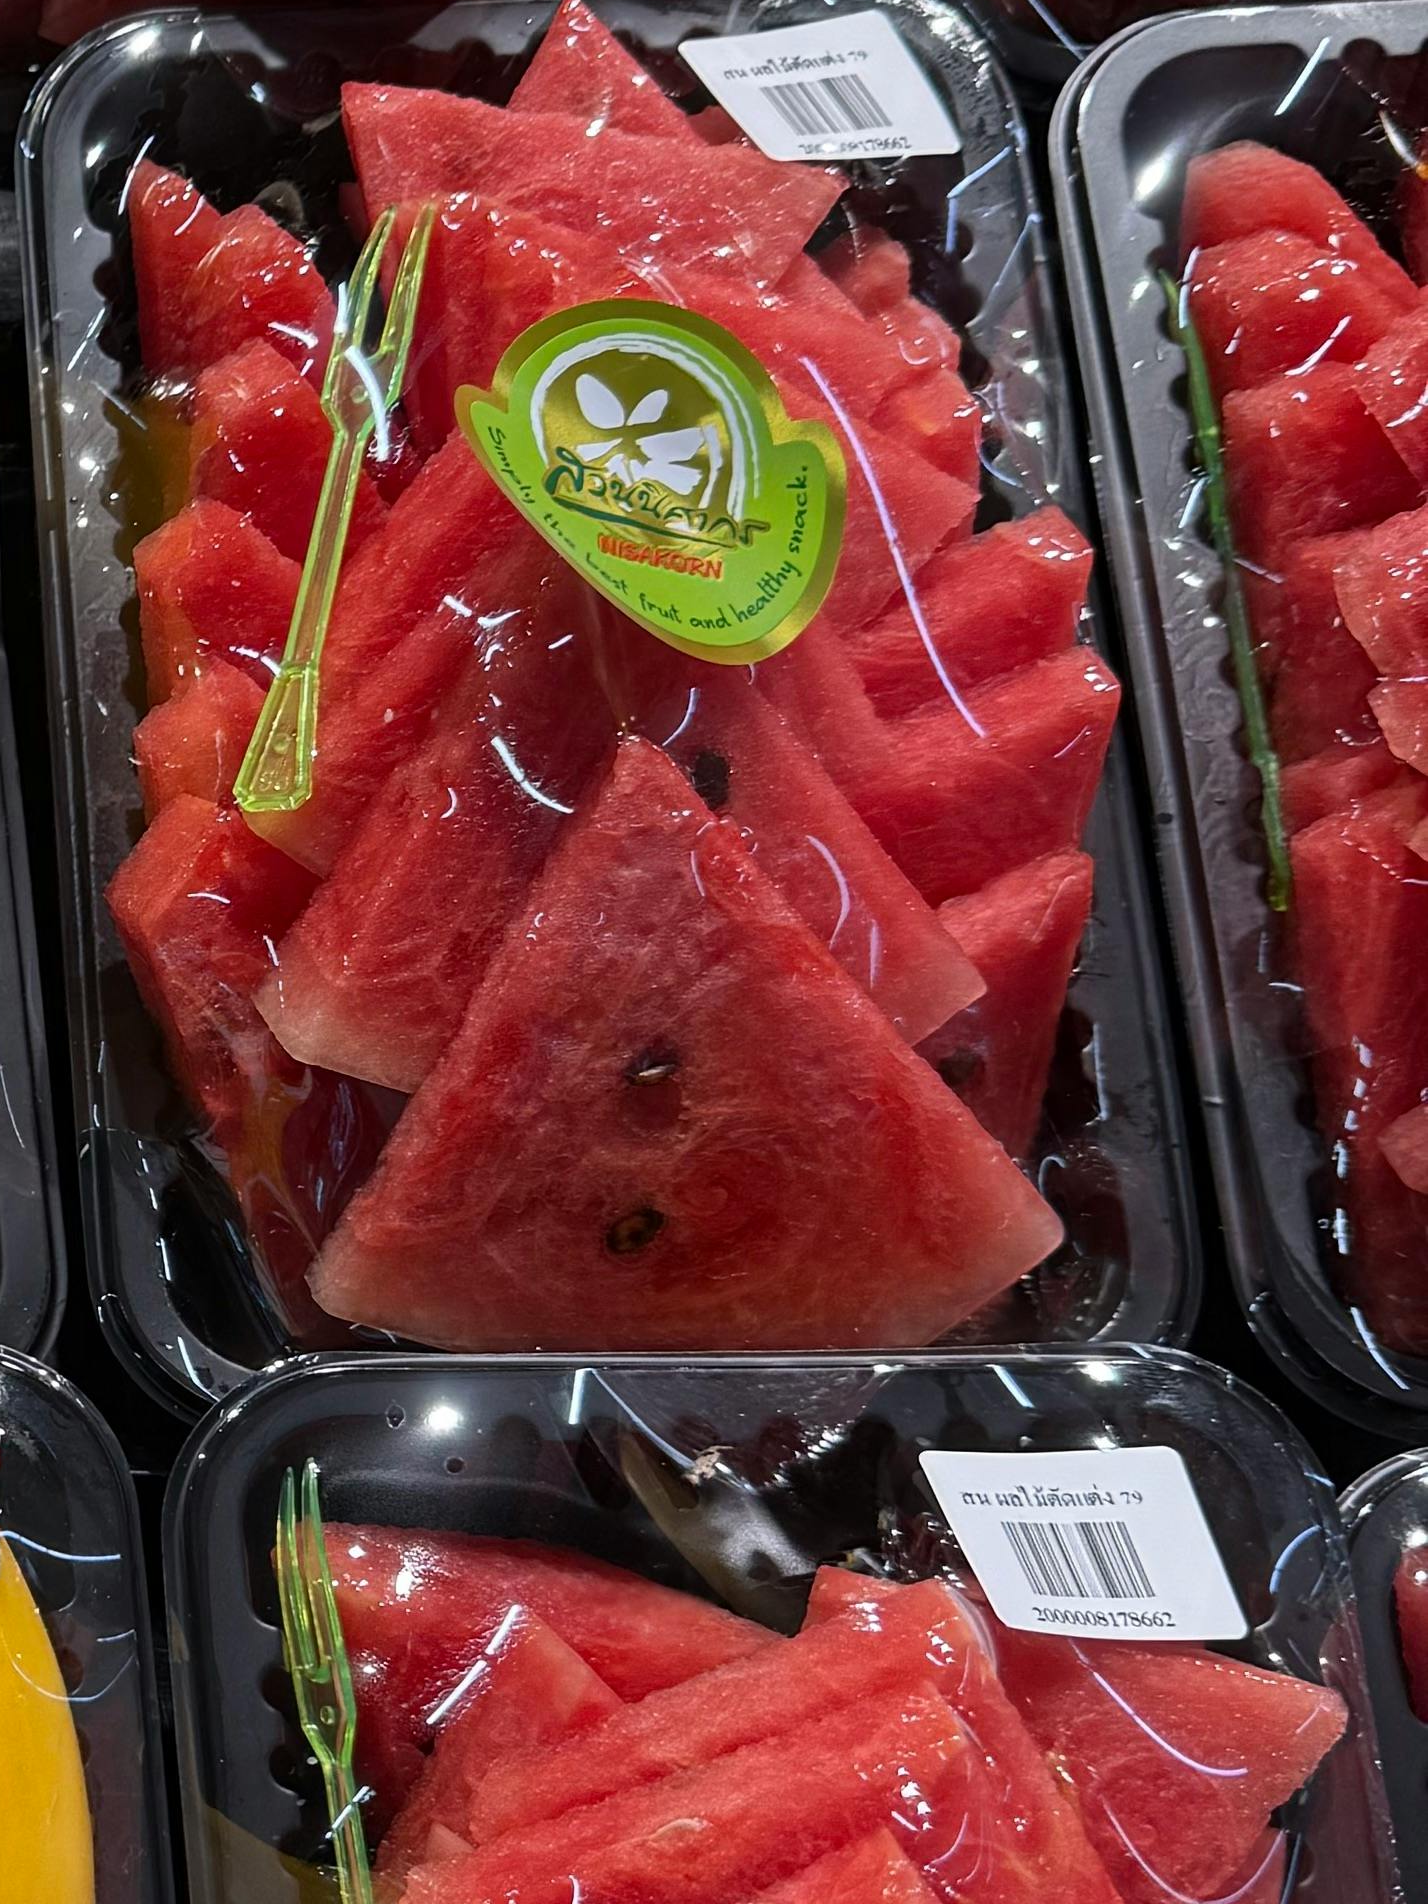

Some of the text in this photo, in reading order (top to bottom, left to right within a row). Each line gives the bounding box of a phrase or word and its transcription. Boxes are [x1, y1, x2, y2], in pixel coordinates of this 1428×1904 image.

[850, 50, 870, 64] 79
[597, 534, 725, 581] NISAKORN
[639, 593, 682, 624] fruit
[689, 607, 731, 630] and
[736, 560, 801, 625] healthy
[786, 464, 810, 553] snack.
[1120, 1489, 1144, 1506] 79
[1033, 1606, 1177, 1628] 2000008178662
